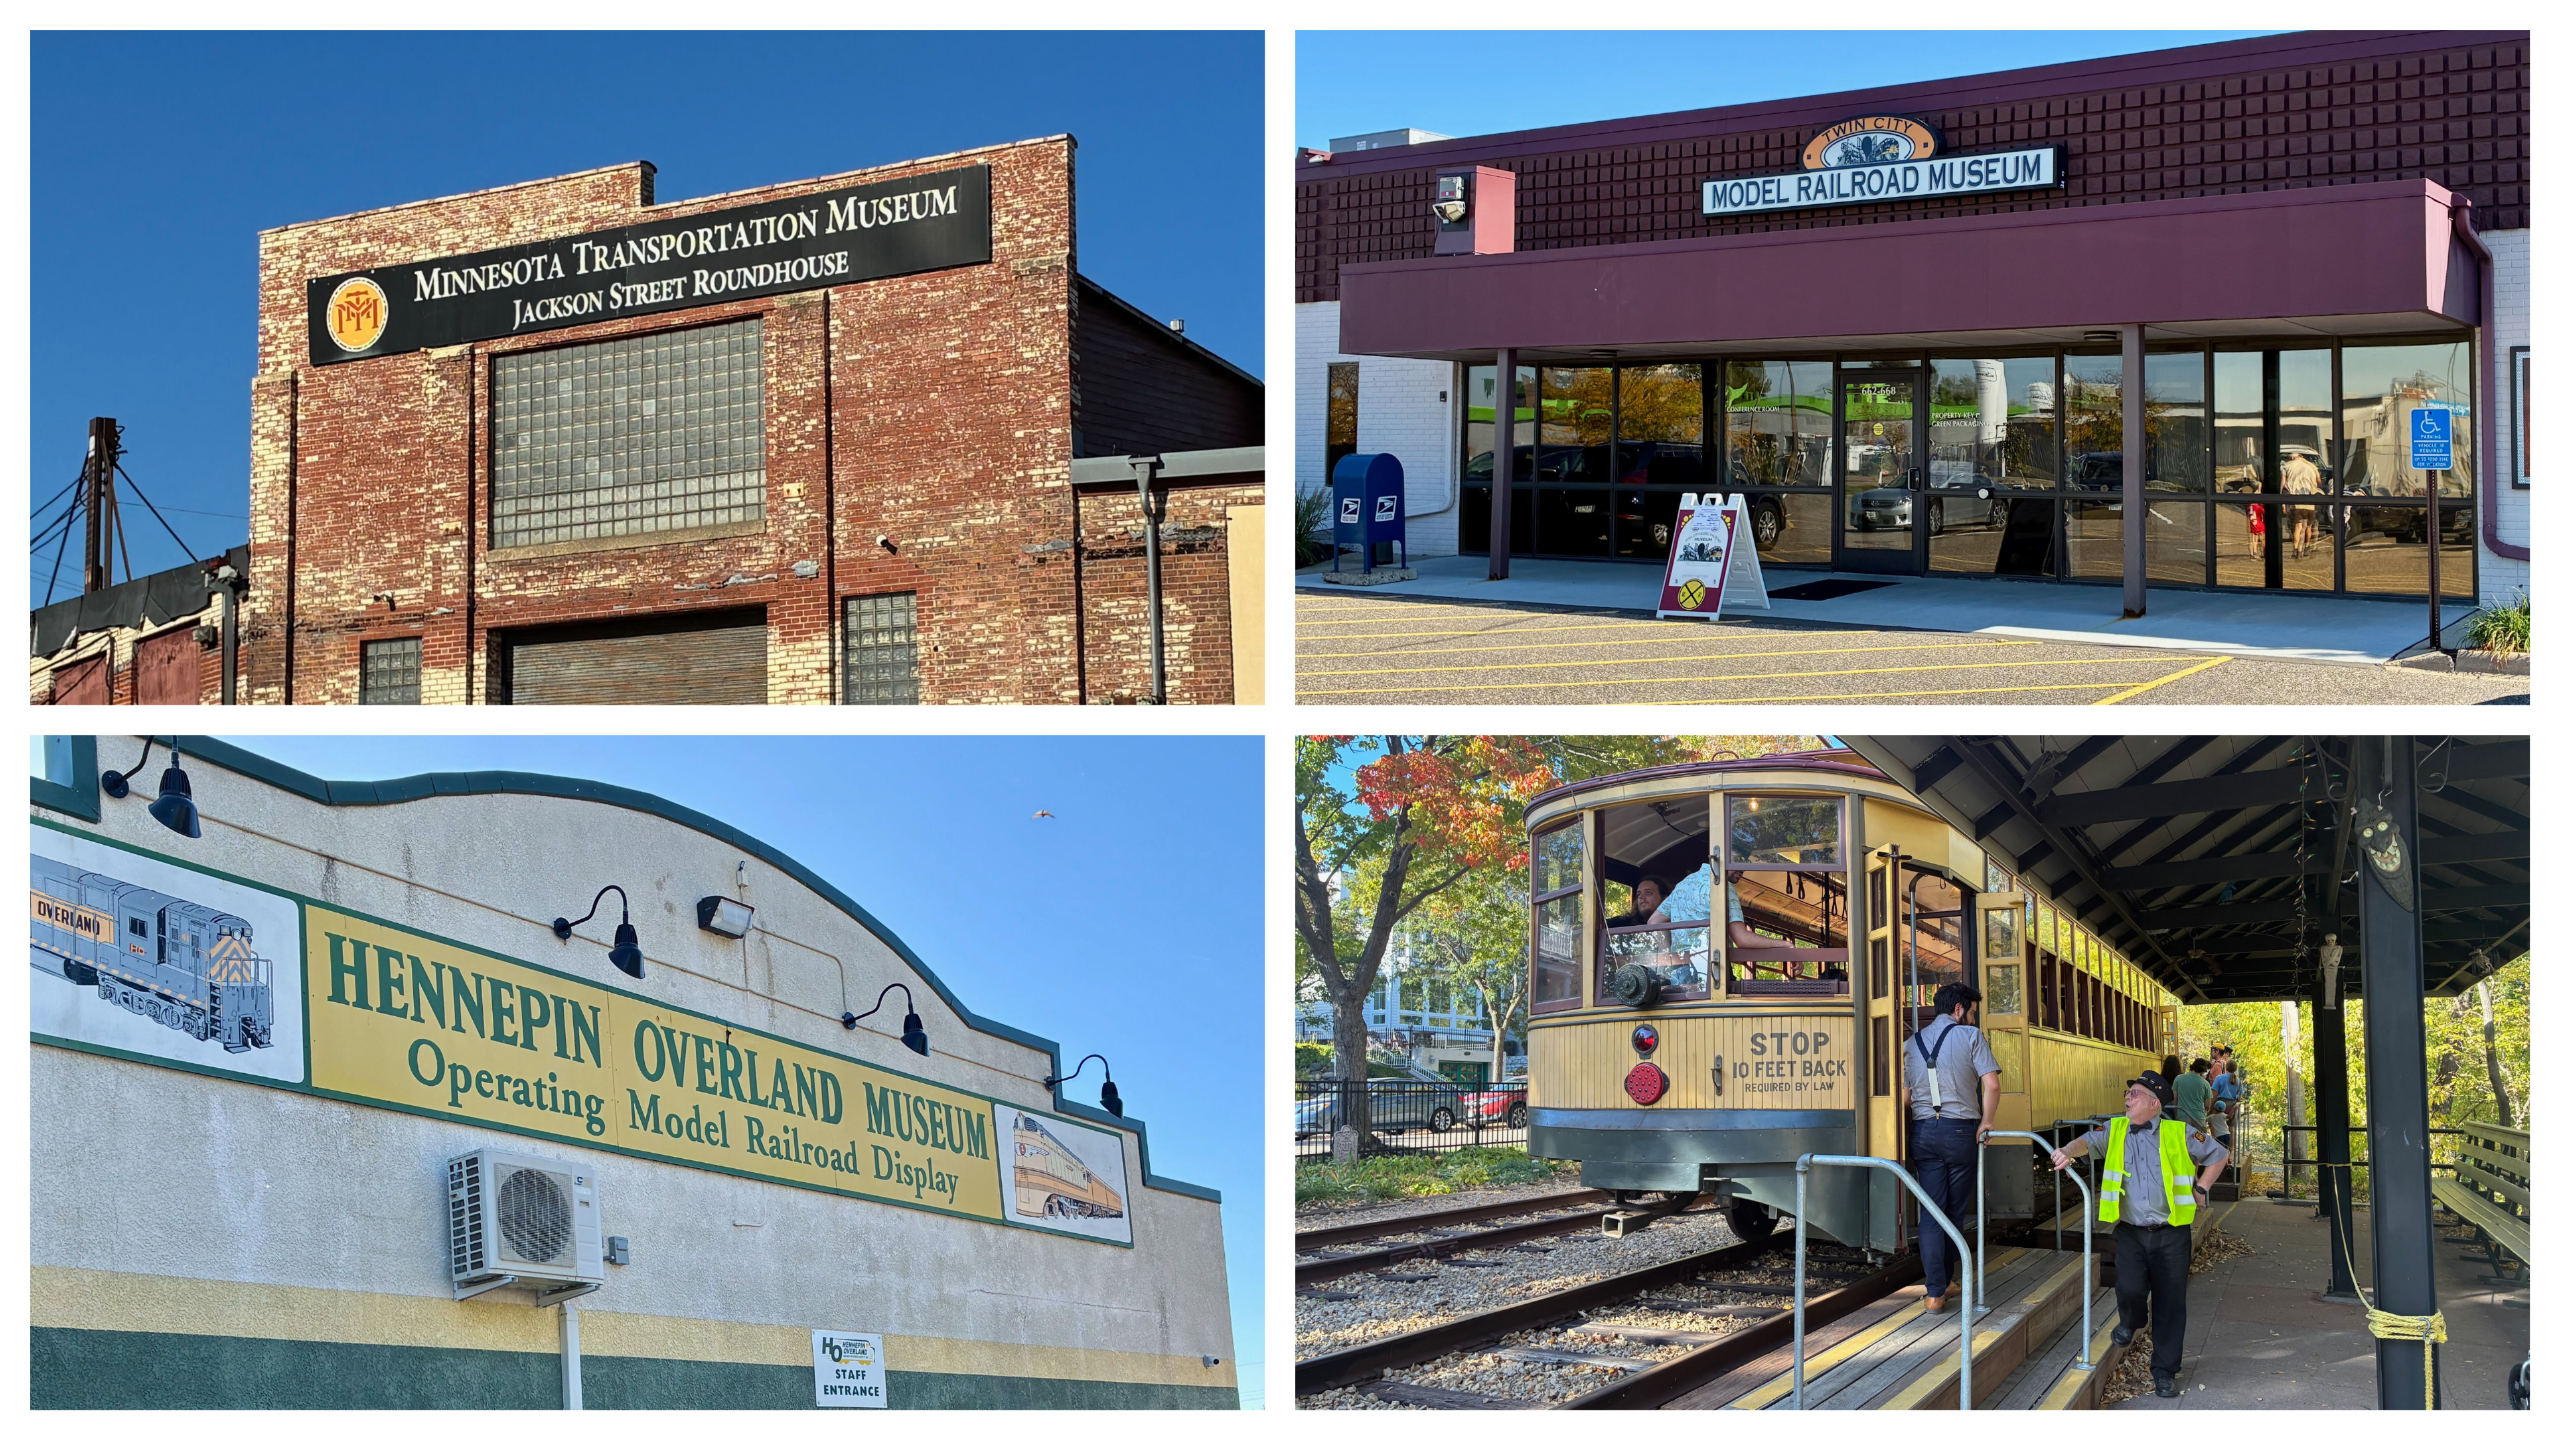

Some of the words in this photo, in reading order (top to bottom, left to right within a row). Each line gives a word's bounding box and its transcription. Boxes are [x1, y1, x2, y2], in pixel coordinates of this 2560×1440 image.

[1822, 119, 1865, 142] TWIN
[1873, 117, 1913, 134] CITY
[1711, 178, 1790, 210] MODEL
[1797, 165, 1919, 203] RAILROAD
[1928, 153, 2041, 191] MUSEUM
[413, 253, 565, 302] MINNESOTA
[572, 209, 819, 276] TRANSPORTATION
[825, 185, 958, 234] MUSEUM
[512, 290, 604, 330] JACKSON
[609, 276, 687, 310] STREET
[693, 251, 849, 296] ROUNDHOUSE
[1861, 386, 1897, 395] 662-668
[37, 900, 101, 936] OVERLAND
[324, 931, 602, 1068] HENNEPIN
[634, 1019, 843, 1125] OVERLAND
[862, 1082, 990, 1160] MUSEUM
[1750, 1031, 1830, 1056] STOP
[1733, 1061, 1749, 1078] 10
[1755, 1061, 1797, 1078] FEET
[1802, 1060, 1846, 1077] BACK
[1745, 1082, 1791, 1092] REQUIRED
[1795, 1082, 1809, 1091] BY
[1814, 1081, 1834, 1091] LAW
[408, 1038, 605, 1136] Operating
[626, 1088, 730, 1148] Model
[744, 1115, 860, 1175] Railroad
[871, 1144, 958, 1204] Display
[822, 1336, 843, 1363] HO
[835, 1368, 866, 1380] STAFF
[823, 1384, 880, 1397] ENTRANCE
